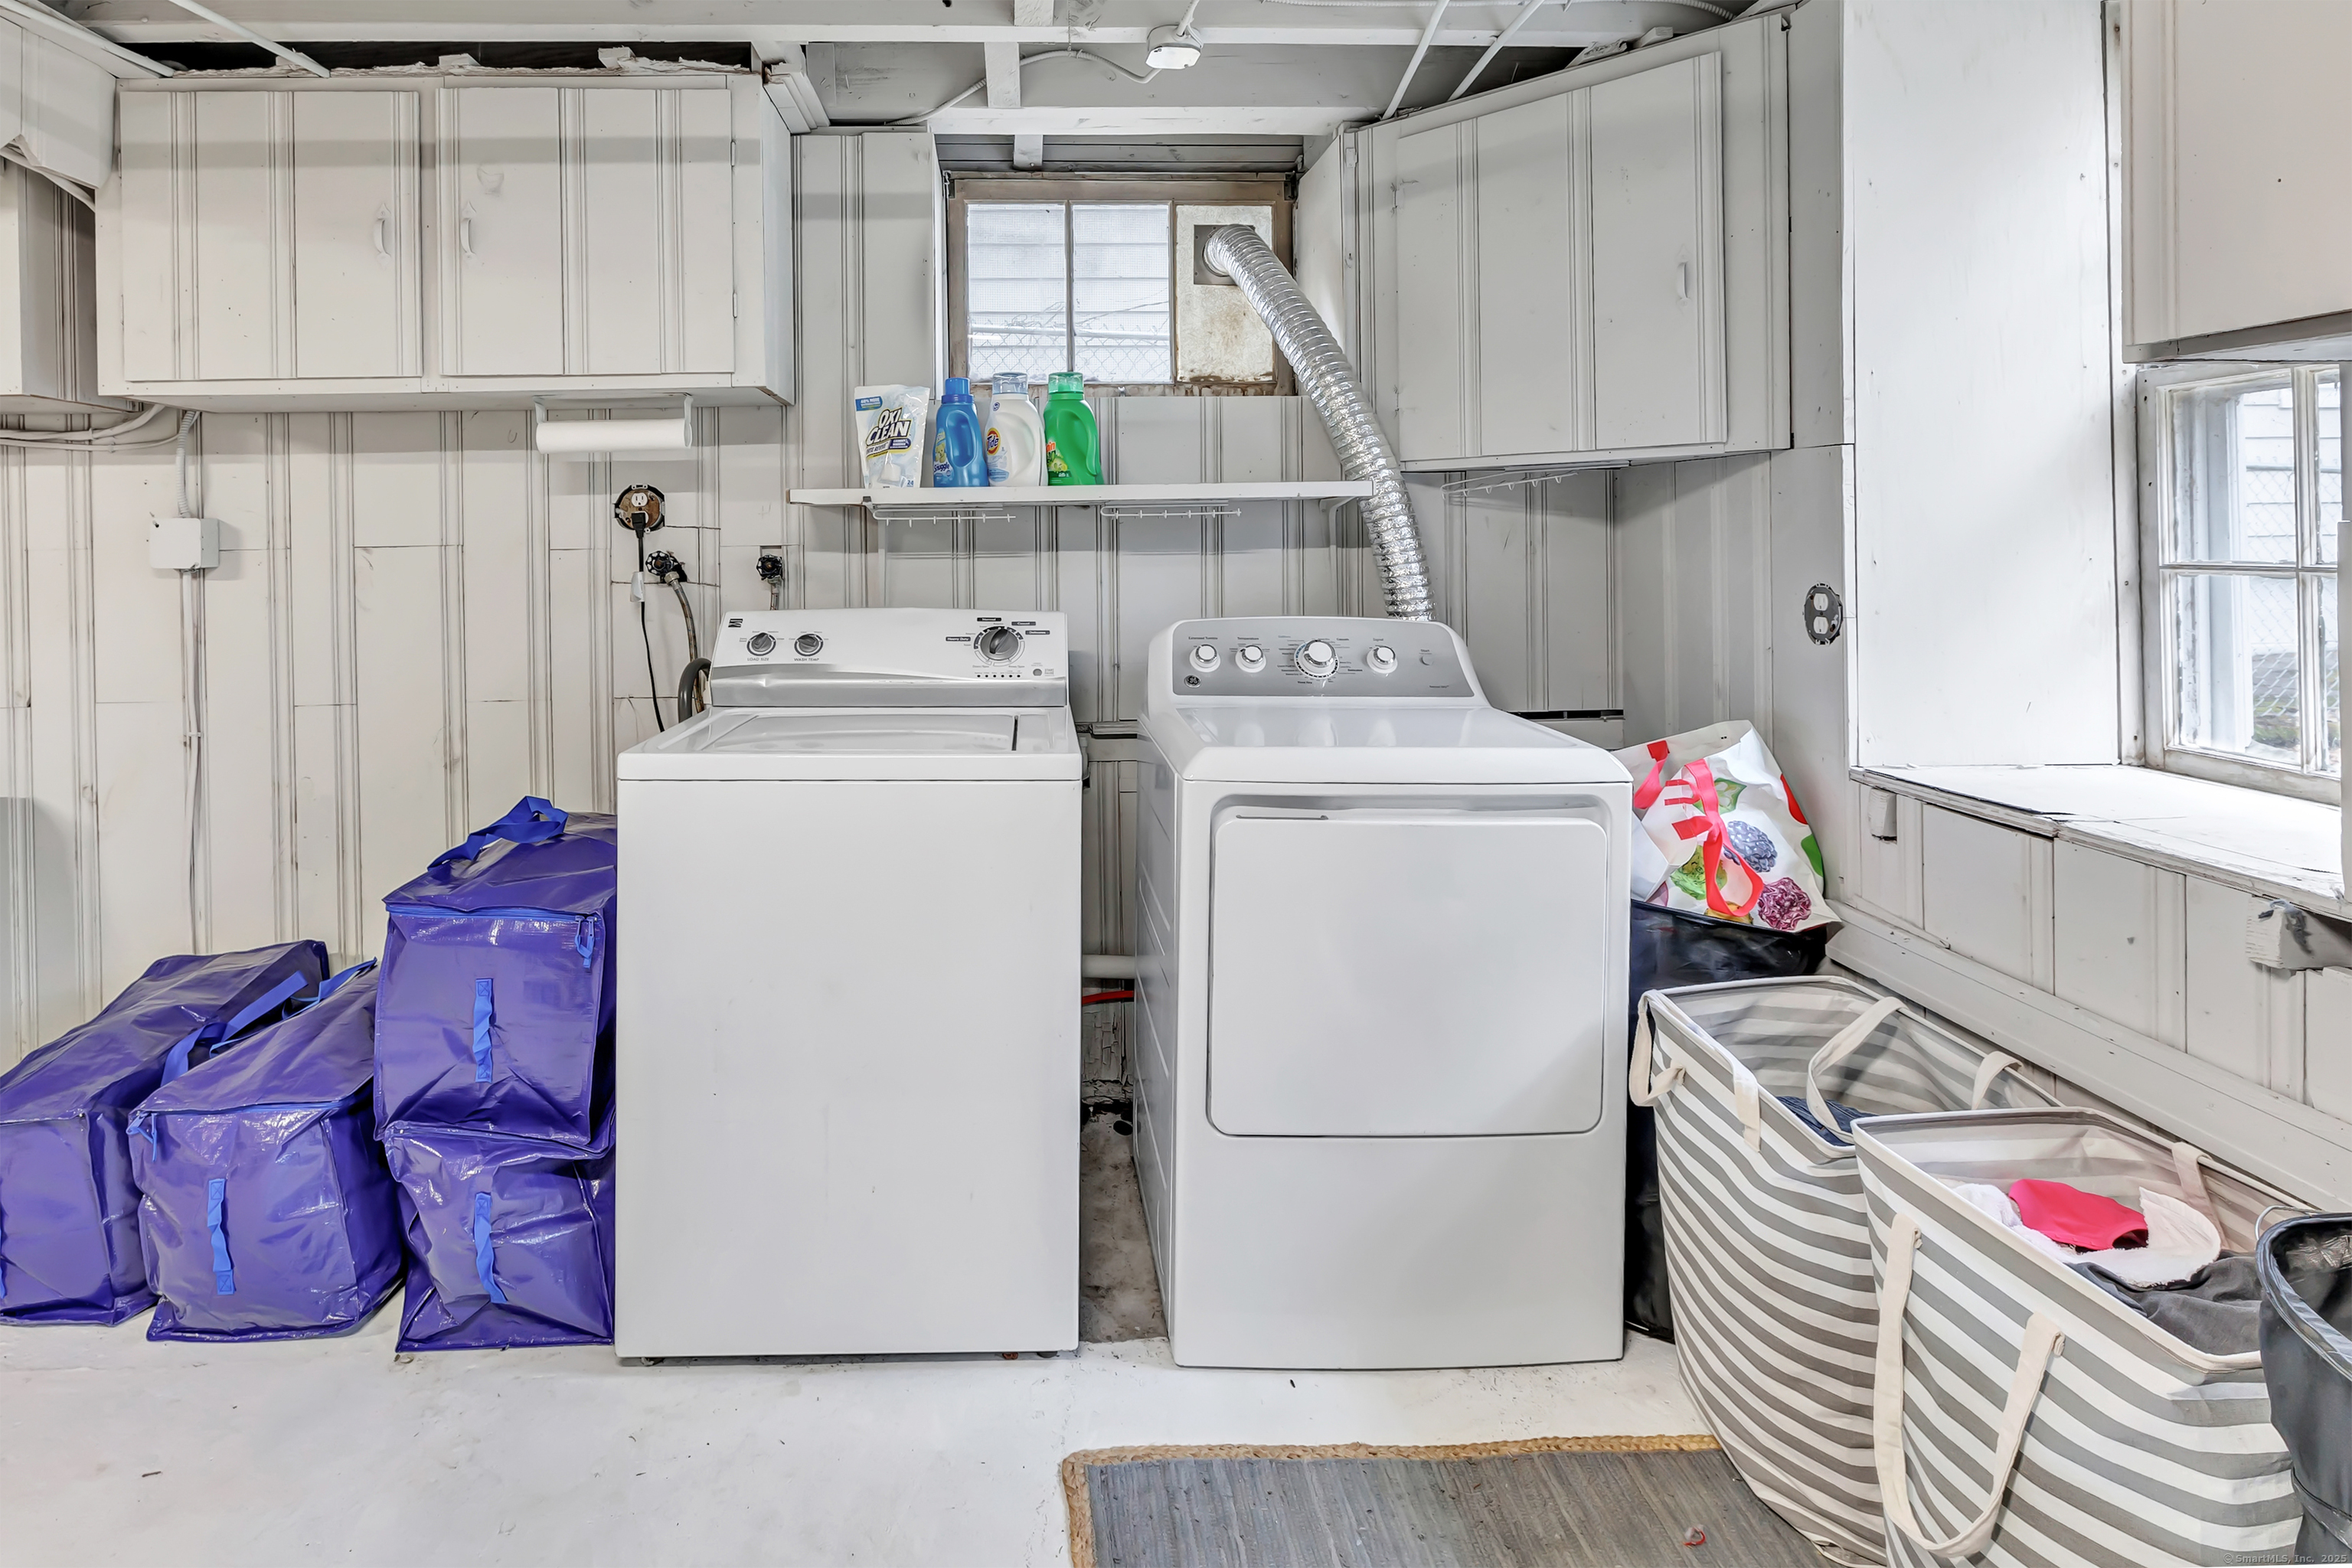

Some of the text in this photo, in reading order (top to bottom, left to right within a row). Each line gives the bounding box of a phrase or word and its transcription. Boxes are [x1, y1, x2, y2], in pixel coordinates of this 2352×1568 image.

[878, 408, 902, 429] OXI
[866, 420, 911, 446] CLEAN
[987, 434, 999, 452] Tide
[934, 462, 950, 472] Snuggle
